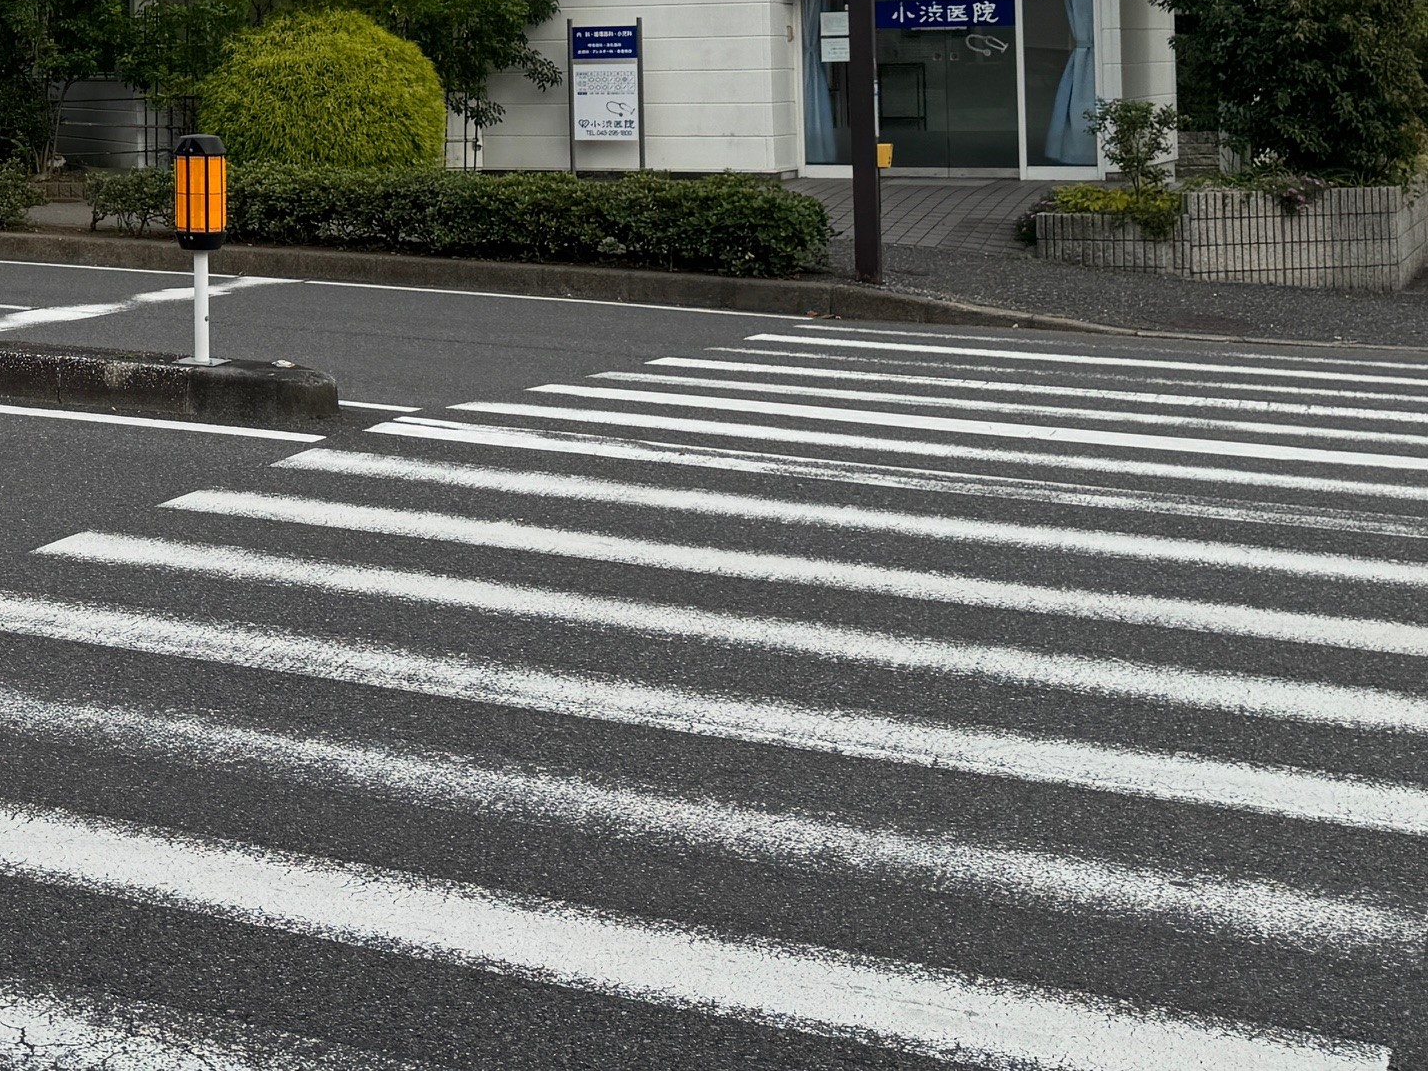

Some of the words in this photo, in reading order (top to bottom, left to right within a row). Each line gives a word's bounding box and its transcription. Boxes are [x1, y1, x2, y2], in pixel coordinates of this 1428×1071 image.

[891, 0, 1000, 24] 小渋医院
[590, 119, 635, 129] 小渋医院
